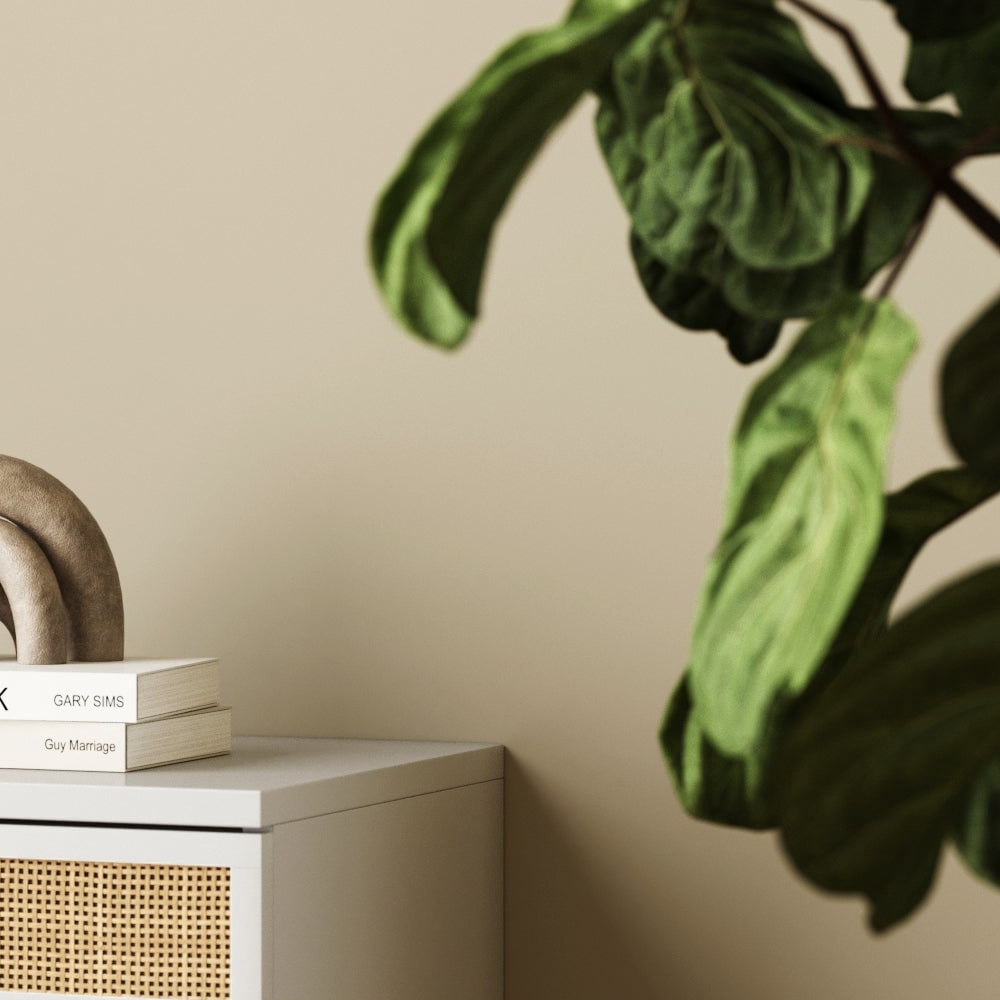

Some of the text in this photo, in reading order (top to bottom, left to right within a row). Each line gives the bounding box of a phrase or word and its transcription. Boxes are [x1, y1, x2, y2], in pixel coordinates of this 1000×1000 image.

[53, 694, 124, 708] GARY SIMS
[44, 738, 115, 755] Guy Marriage
